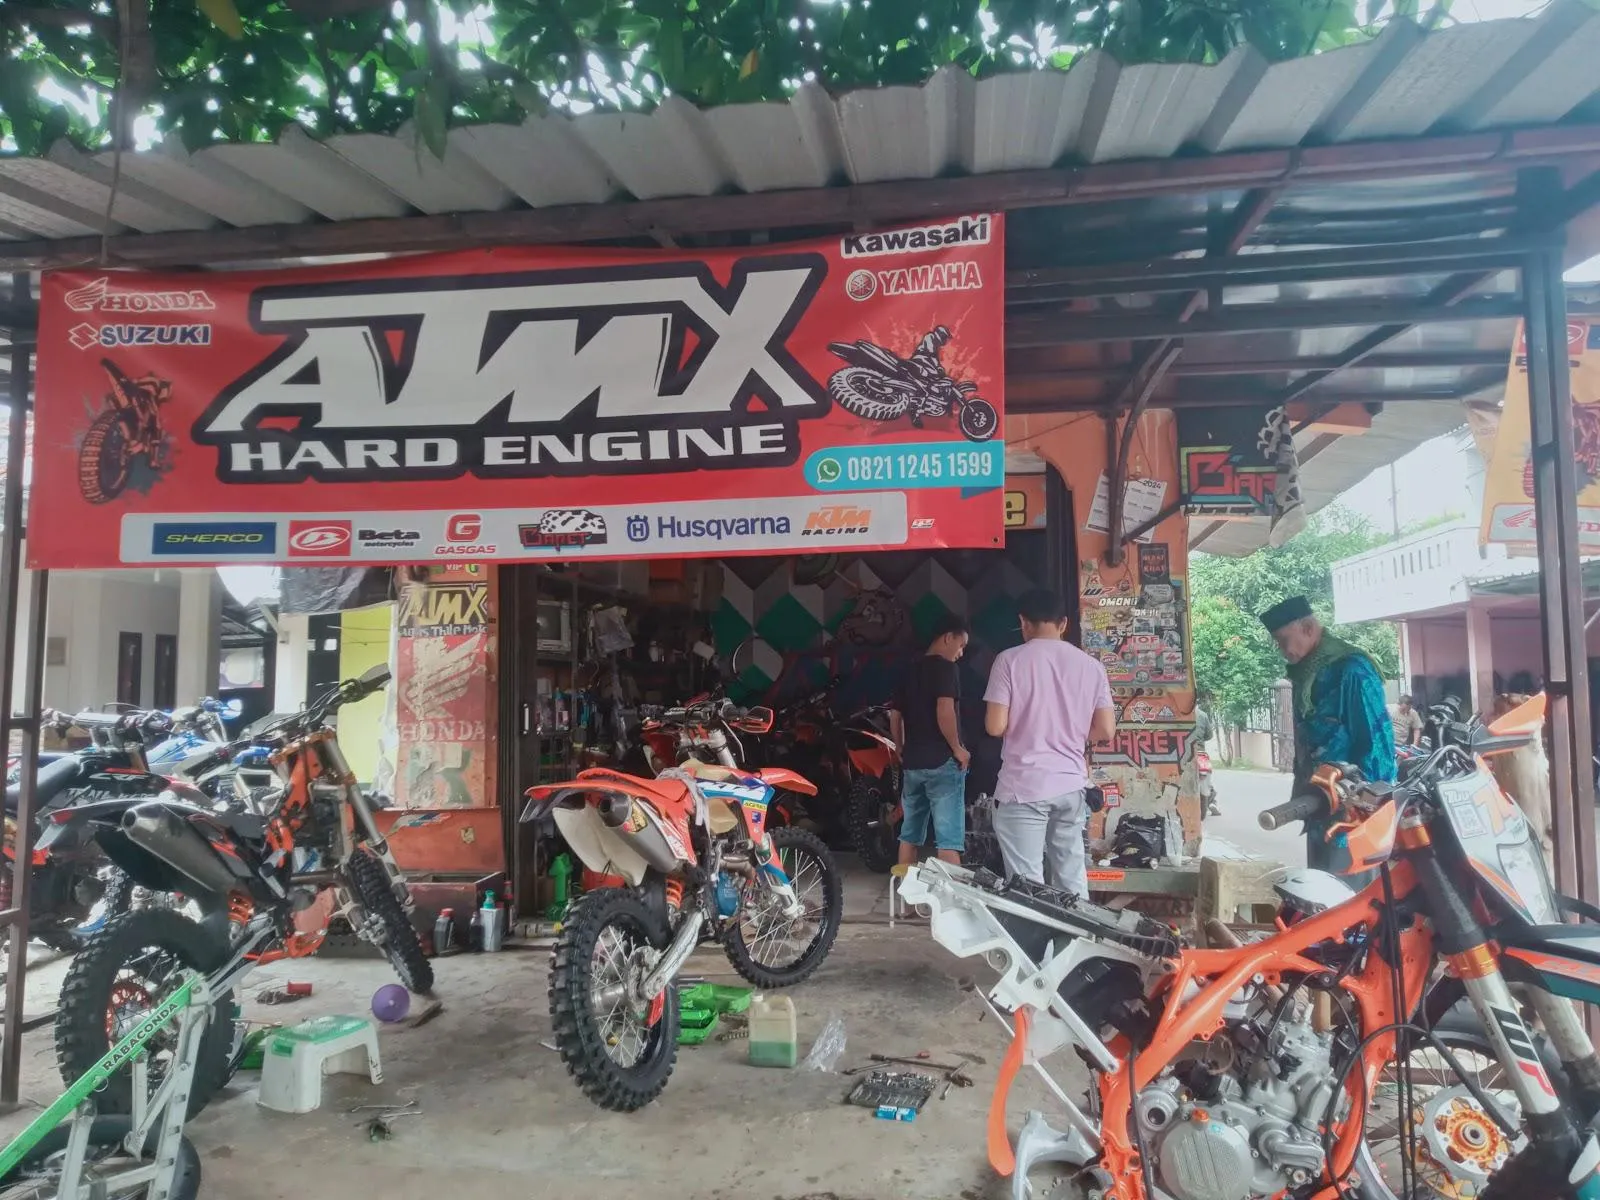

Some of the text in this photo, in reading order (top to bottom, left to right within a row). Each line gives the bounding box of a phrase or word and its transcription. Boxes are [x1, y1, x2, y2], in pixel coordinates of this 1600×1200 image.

[842, 216, 989, 256] Kawasaki
[879, 262, 982, 295] YAMAHA
[101, 291, 215, 312] HONDA
[100, 324, 211, 346] SUZUKI
[230, 423, 786, 472] HARD ENGINE
[848, 451, 992, 481] 0821 1245 1599
[658, 516, 791, 540] Husqvarna
[805, 506, 871, 529] KTM
[165, 534, 263, 543] SHERCO
[358, 529, 420, 541] Beta
[801, 527, 868, 536] RACING
[364, 540, 414, 549] motorcycles
[435, 545, 496, 554] GASGAS
[103, 1003, 177, 1071] RABACONDA
